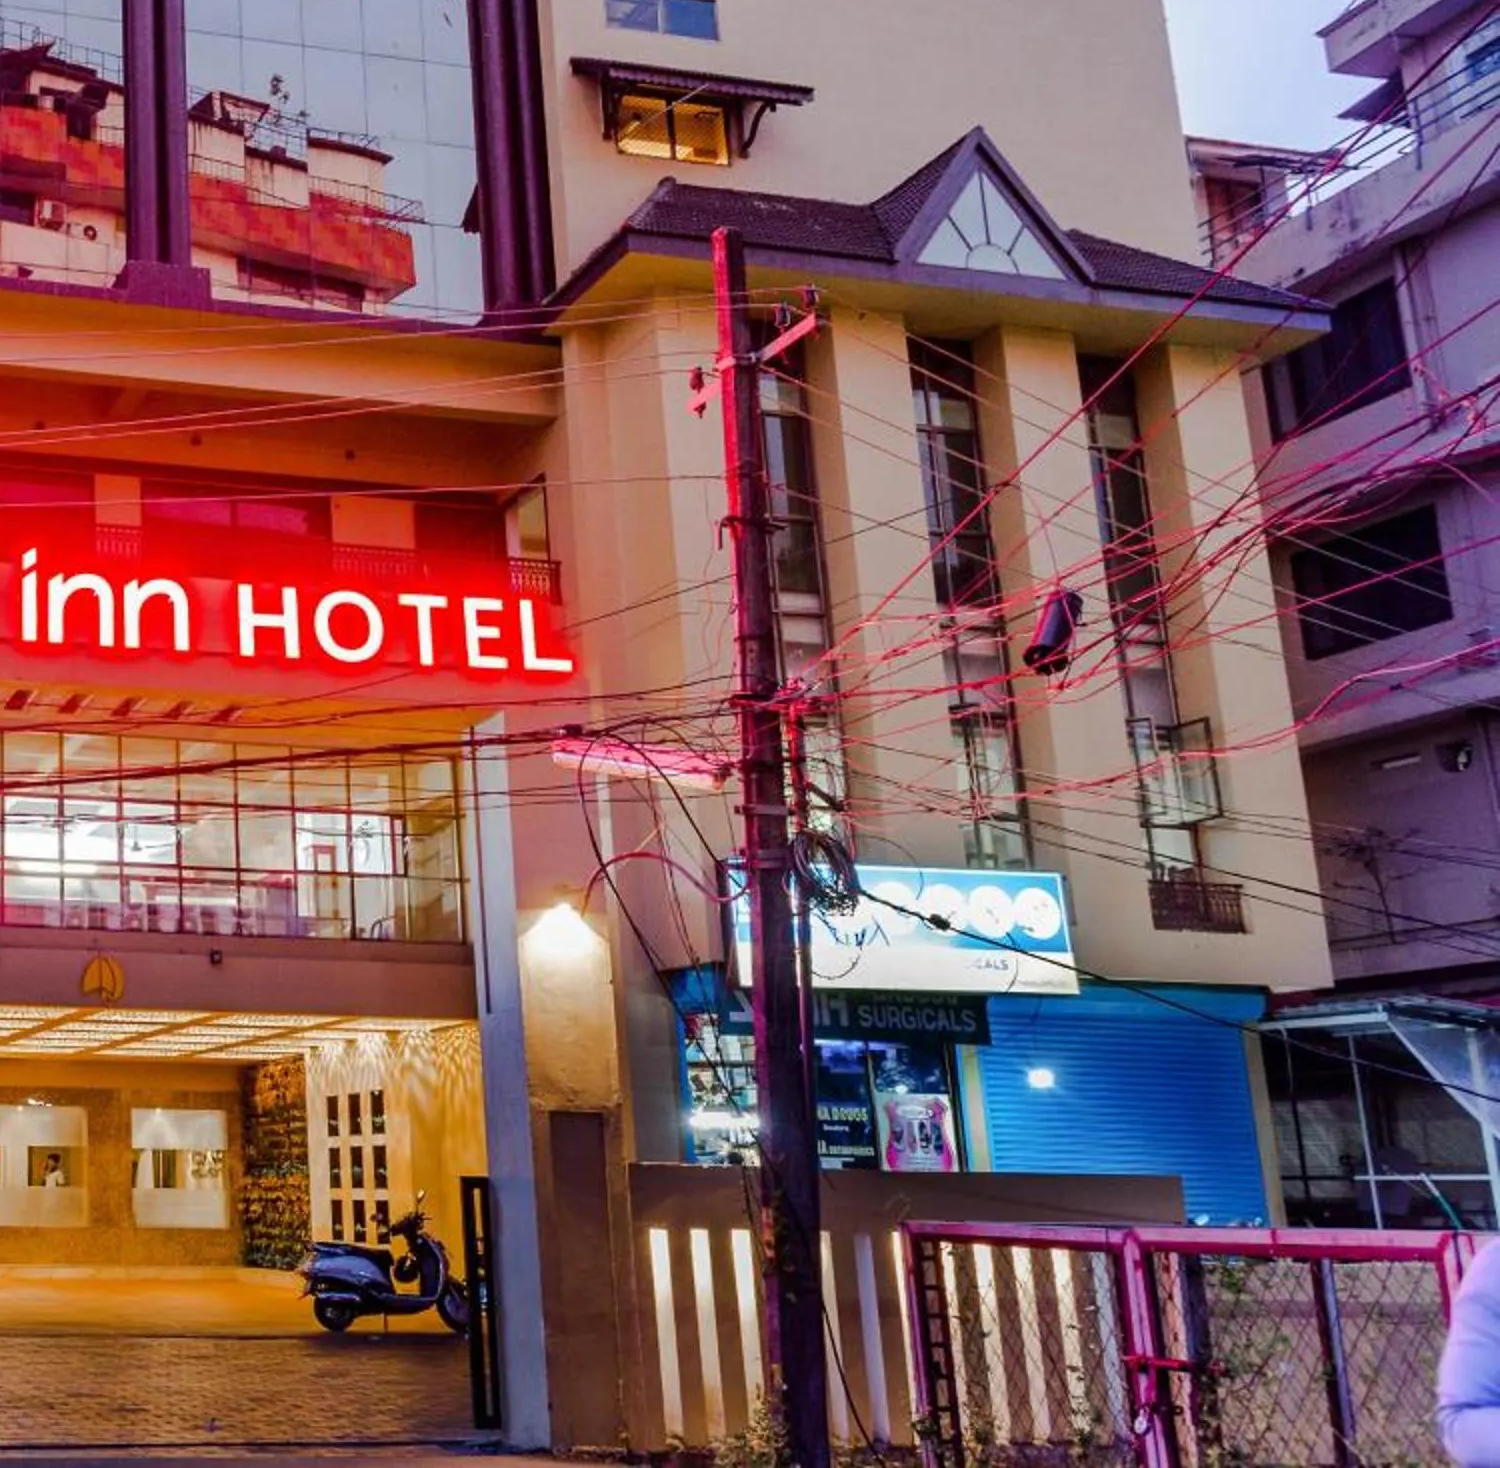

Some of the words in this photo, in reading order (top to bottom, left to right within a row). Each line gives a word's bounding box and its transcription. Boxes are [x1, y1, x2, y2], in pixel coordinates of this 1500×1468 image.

[21, 547, 190, 651] inn
[237, 583, 573, 672] HOTEL
[857, 1004, 977, 1033] SURGICALS
